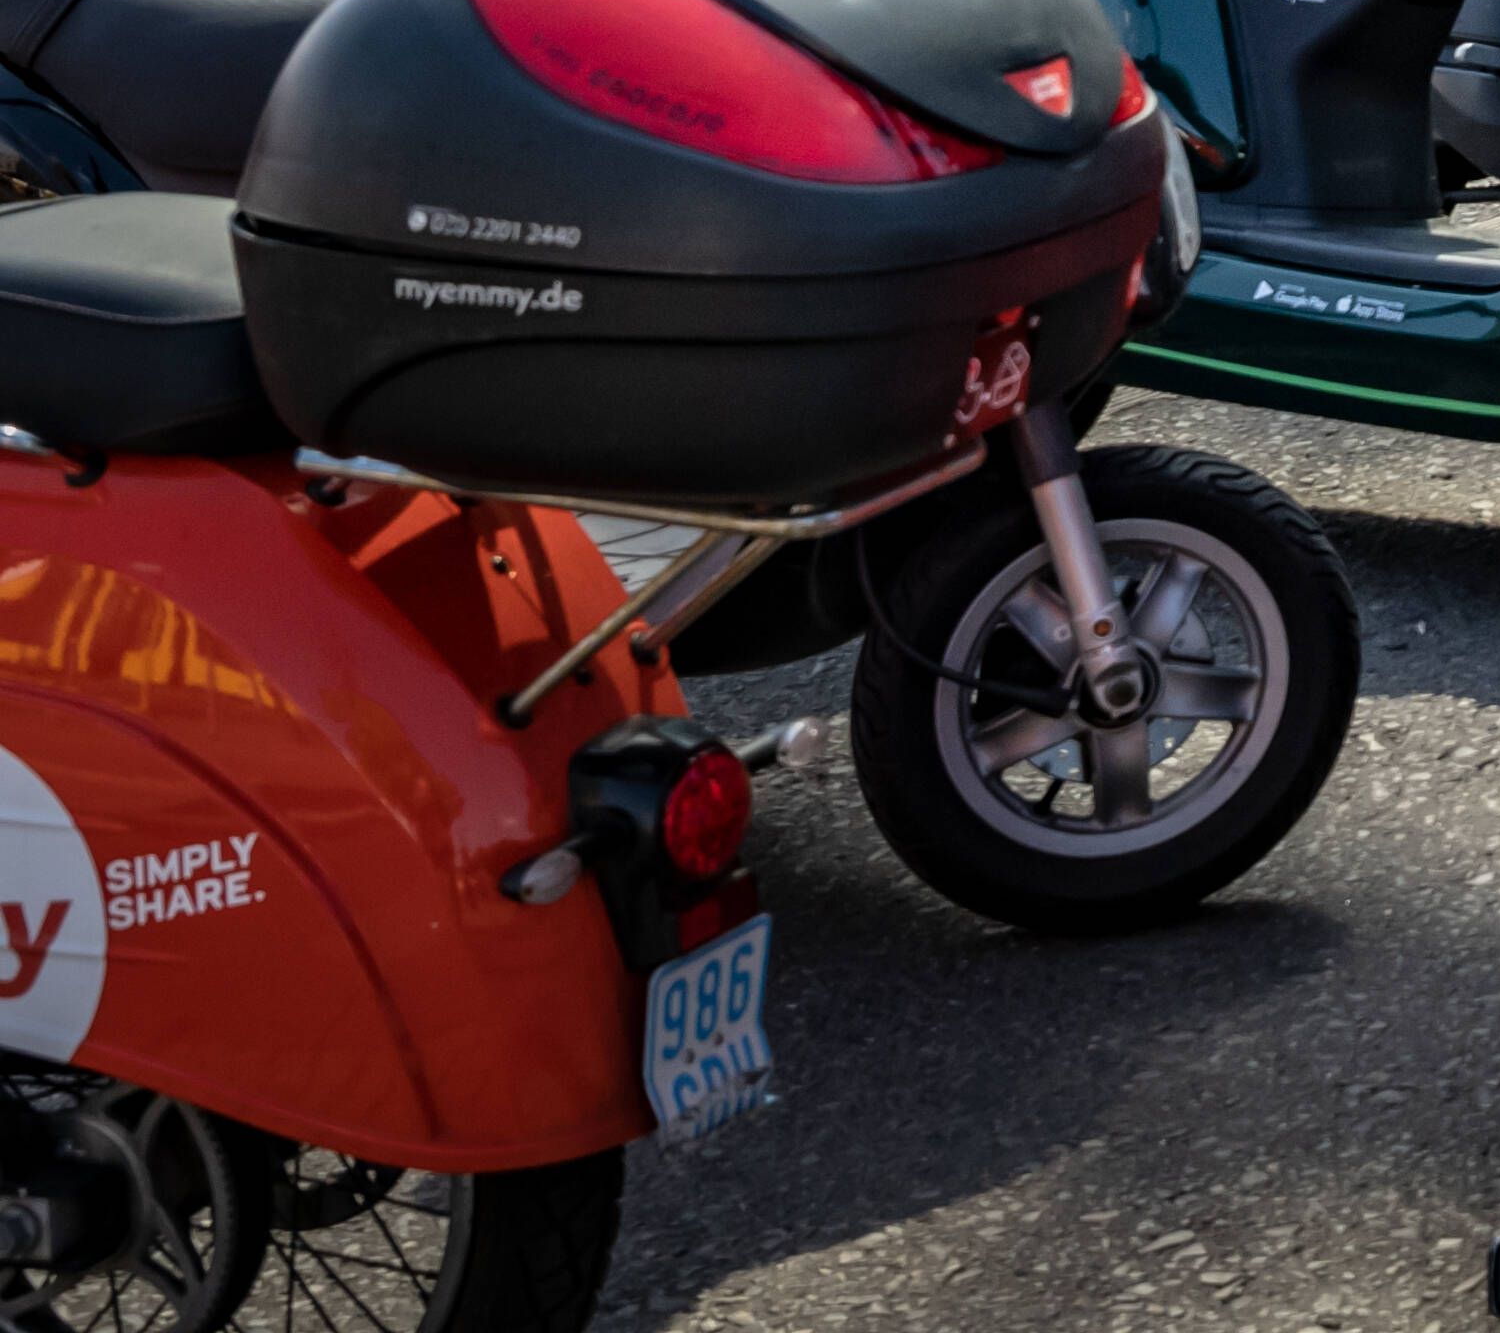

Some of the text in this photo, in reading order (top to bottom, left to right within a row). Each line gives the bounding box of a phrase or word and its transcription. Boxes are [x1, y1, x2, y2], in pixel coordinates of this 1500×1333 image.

[394, 278, 583, 317] myemmy.de
[106, 833, 258, 893] SIMPLY
[108, 871, 266, 931] SHARE.
[662, 942, 754, 1061] 986
